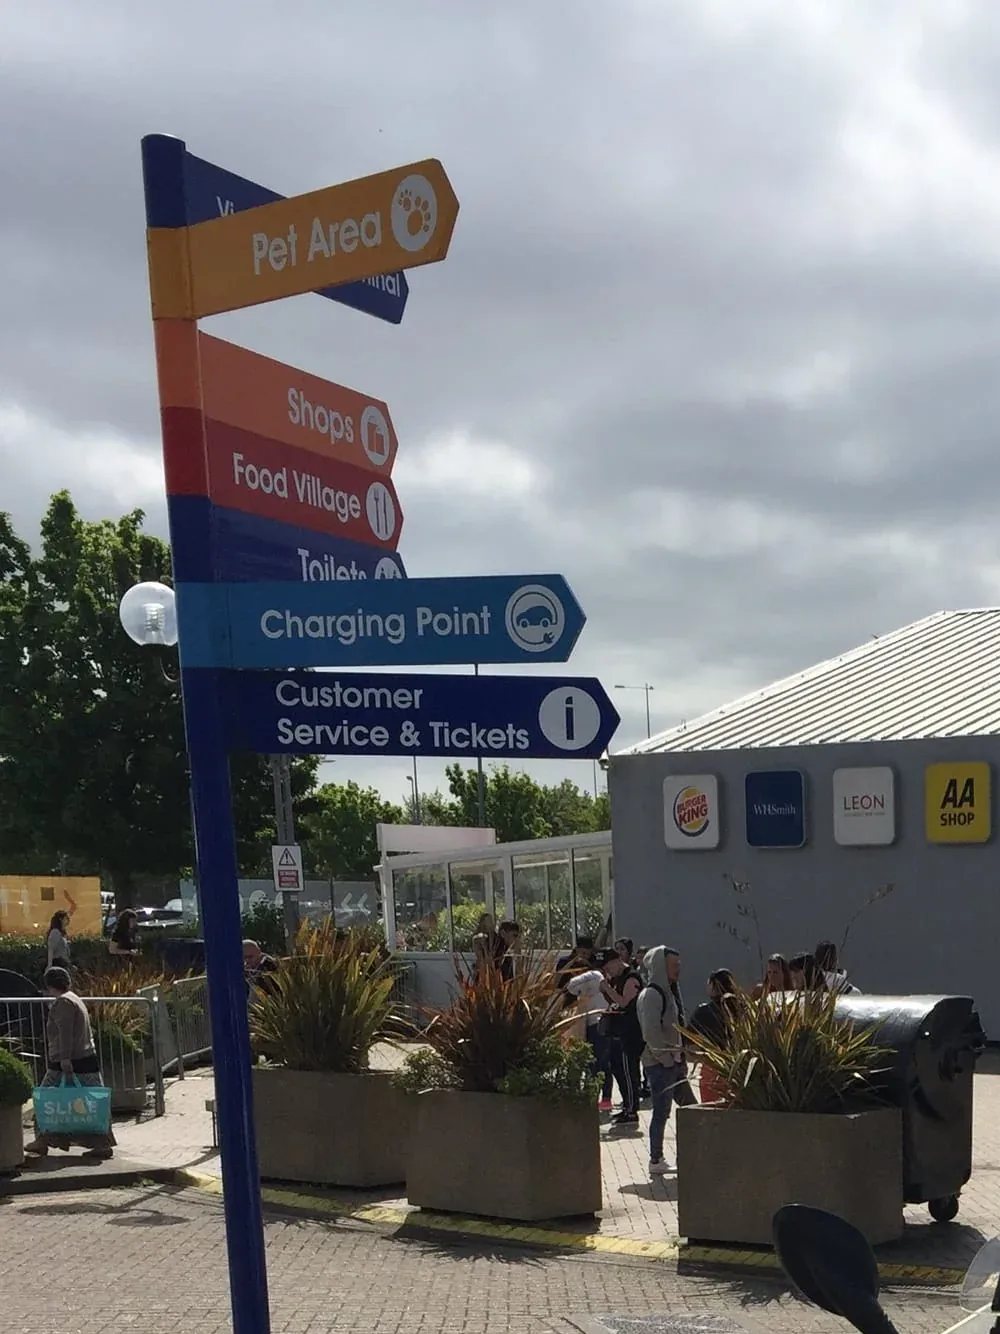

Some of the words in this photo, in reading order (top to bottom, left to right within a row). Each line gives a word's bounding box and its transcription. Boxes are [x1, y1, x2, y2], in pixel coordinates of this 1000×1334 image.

[252, 224, 298, 276] Pet
[307, 211, 382, 262] Area
[287, 387, 354, 444] Shops
[232, 452, 289, 499] Food
[292, 470, 362, 524] Village
[260, 607, 406, 646] Charging
[416, 604, 492, 637] Point
[275, 679, 424, 710] Customer
[277, 717, 390, 747] Service
[399, 720, 422, 748] &
[428, 721, 530, 750] Tickets
[676, 793, 707, 814] BURGER
[842, 794, 886, 811] LEON
[940, 777, 975, 810] AA
[678, 803, 709, 827] KING
[752, 803, 797, 817] WHSmith
[939, 811, 976, 827] SHOP
